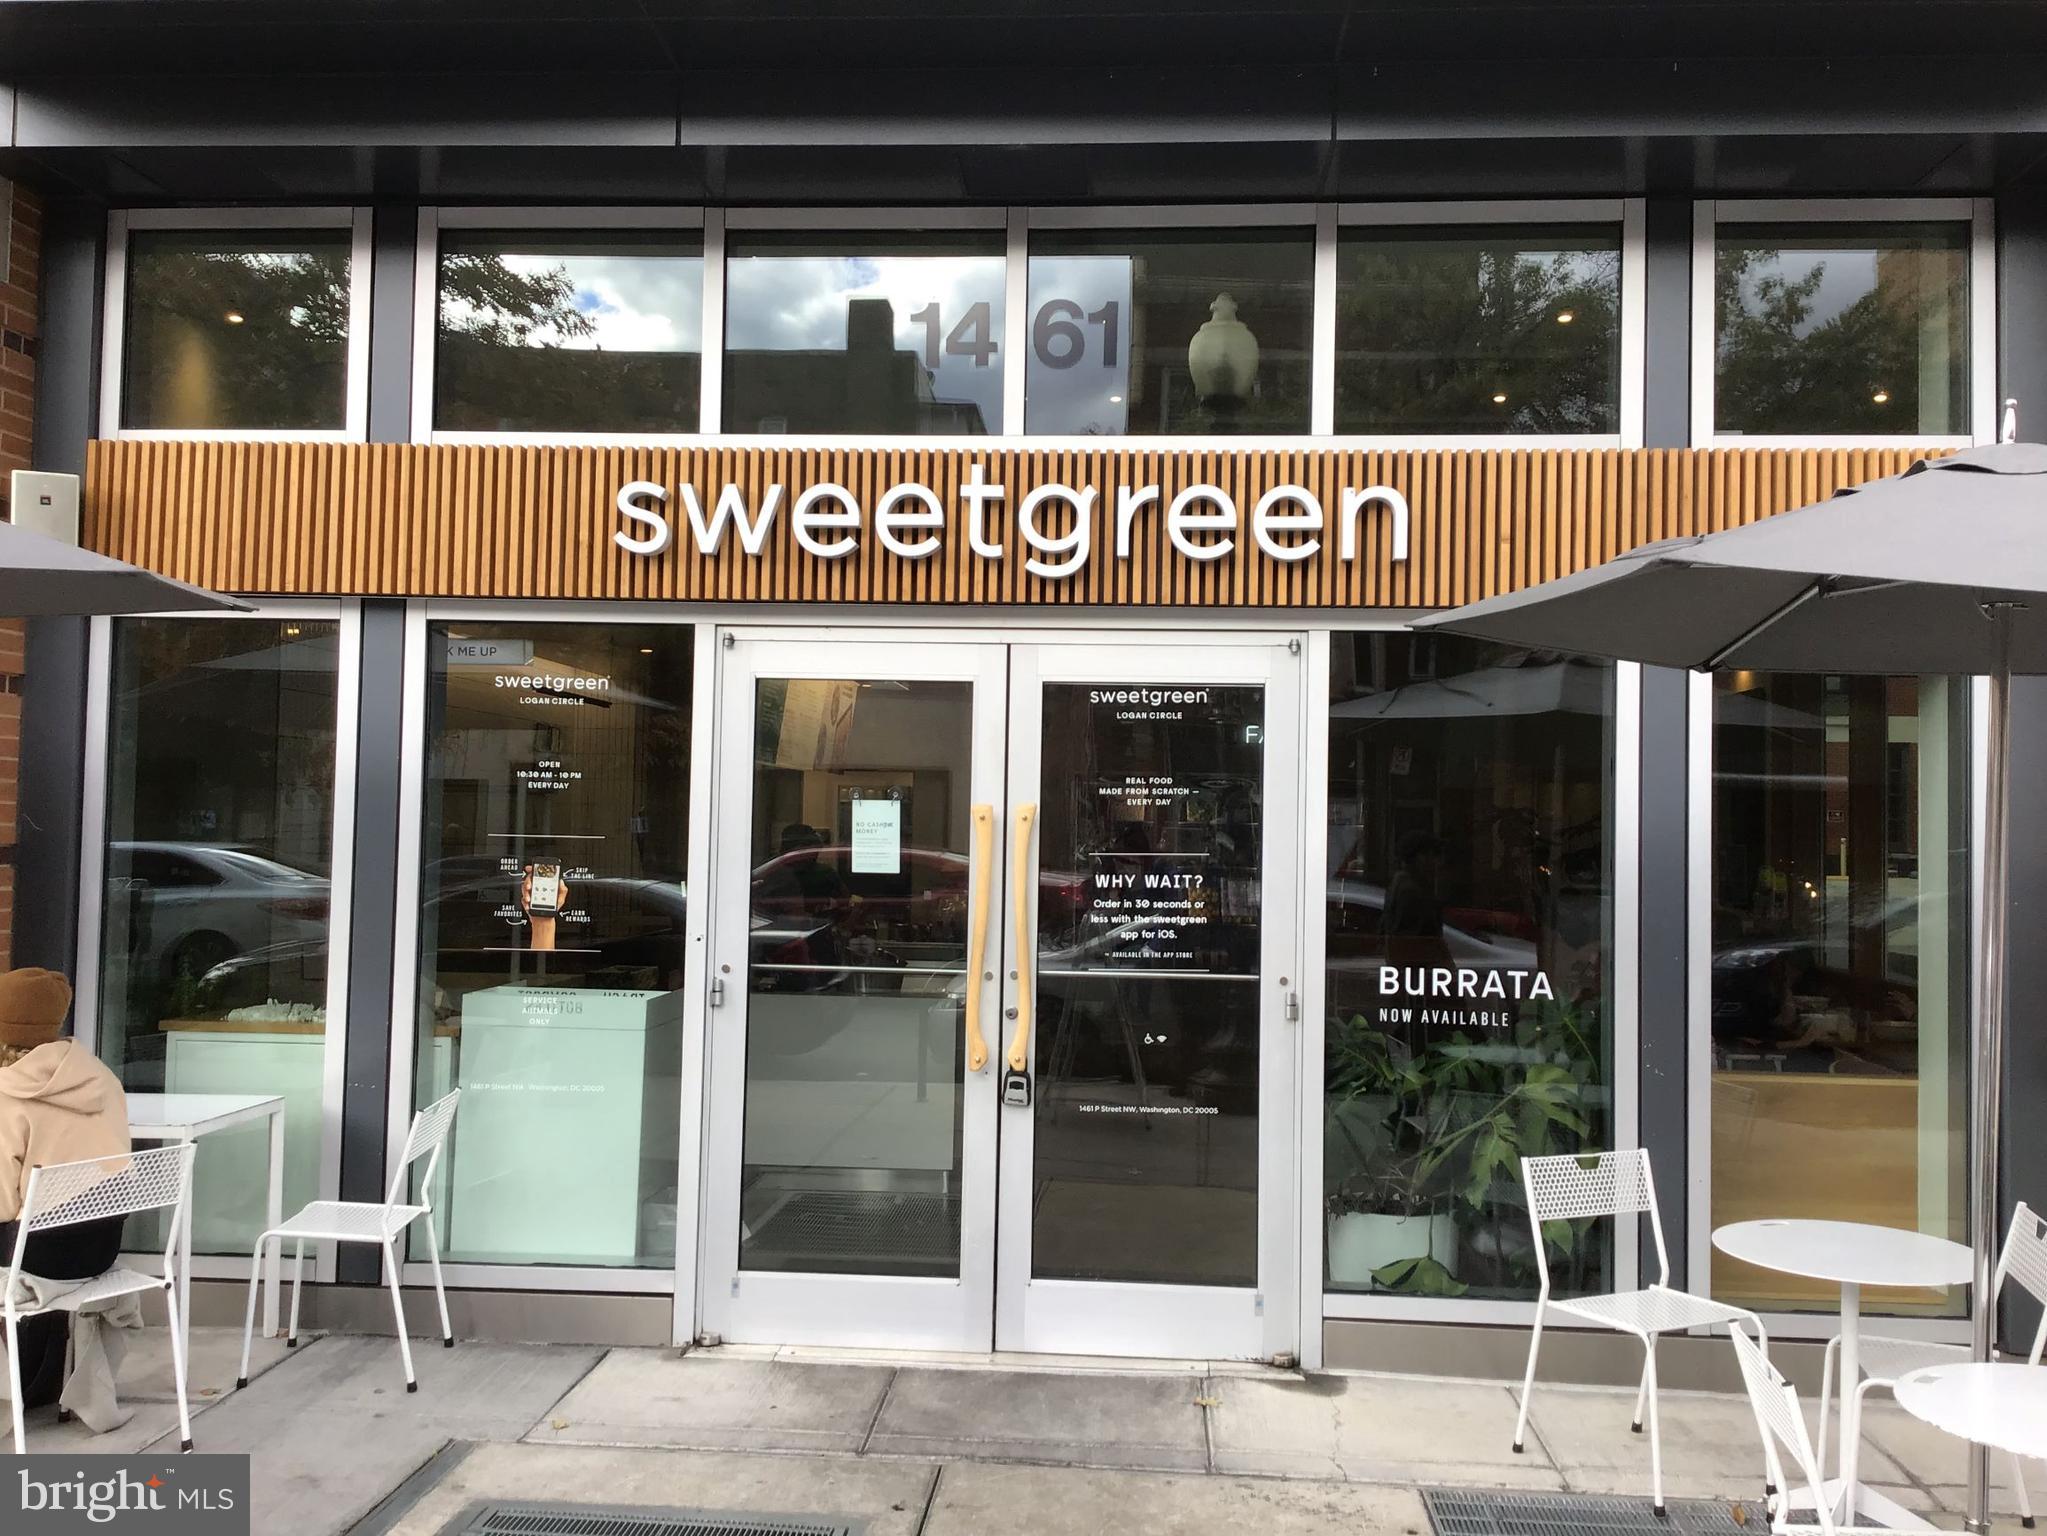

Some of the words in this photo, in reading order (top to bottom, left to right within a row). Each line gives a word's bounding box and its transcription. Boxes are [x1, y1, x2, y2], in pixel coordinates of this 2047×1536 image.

[612, 462, 1410, 582] sweetgreen
[458, 647, 476, 657] ME
[480, 647, 497, 657] UP
[495, 674, 610, 691] sweetgreen
[520, 697, 550, 705] LOGAN
[552, 698, 585, 706] CIRCLE
[1090, 688, 1208, 706] sweetgreen
[1117, 711, 1147, 719] LOGAN
[1149, 712, 1183, 720] CIRCLE
[559, 771, 569, 779] 10
[528, 781, 552, 789] EVERY
[1126, 777, 1146, 785] REAL
[1149, 777, 1173, 785] FOOD
[1127, 798, 1152, 806] EVERY
[1155, 798, 1171, 806] DAY
[1095, 874, 1137, 888] WHY
[1145, 874, 1204, 889] WAIT?
[1093, 899, 1121, 908] Order
[1124, 899, 1132, 908] in
[1135, 899, 1150, 908] 30
[1153, 899, 1192, 909] seconds
[1091, 915, 1109, 923] less
[1111, 915, 1131, 923] with
[1134, 915, 1150, 924] the
[1152, 915, 1208, 926] sweetgreen
[1120, 932, 1139, 941] app
[1141, 930, 1156, 939] for
[1158, 930, 1178, 939] iOS.
[1379, 966, 1555, 1000] BURRATA
[523, 996, 558, 1004] SERVICE
[1379, 1008, 1413, 1023] NOW
[1421, 1009, 1509, 1027] AVAILABLE
[1101, 1105, 1122, 1113] Street
